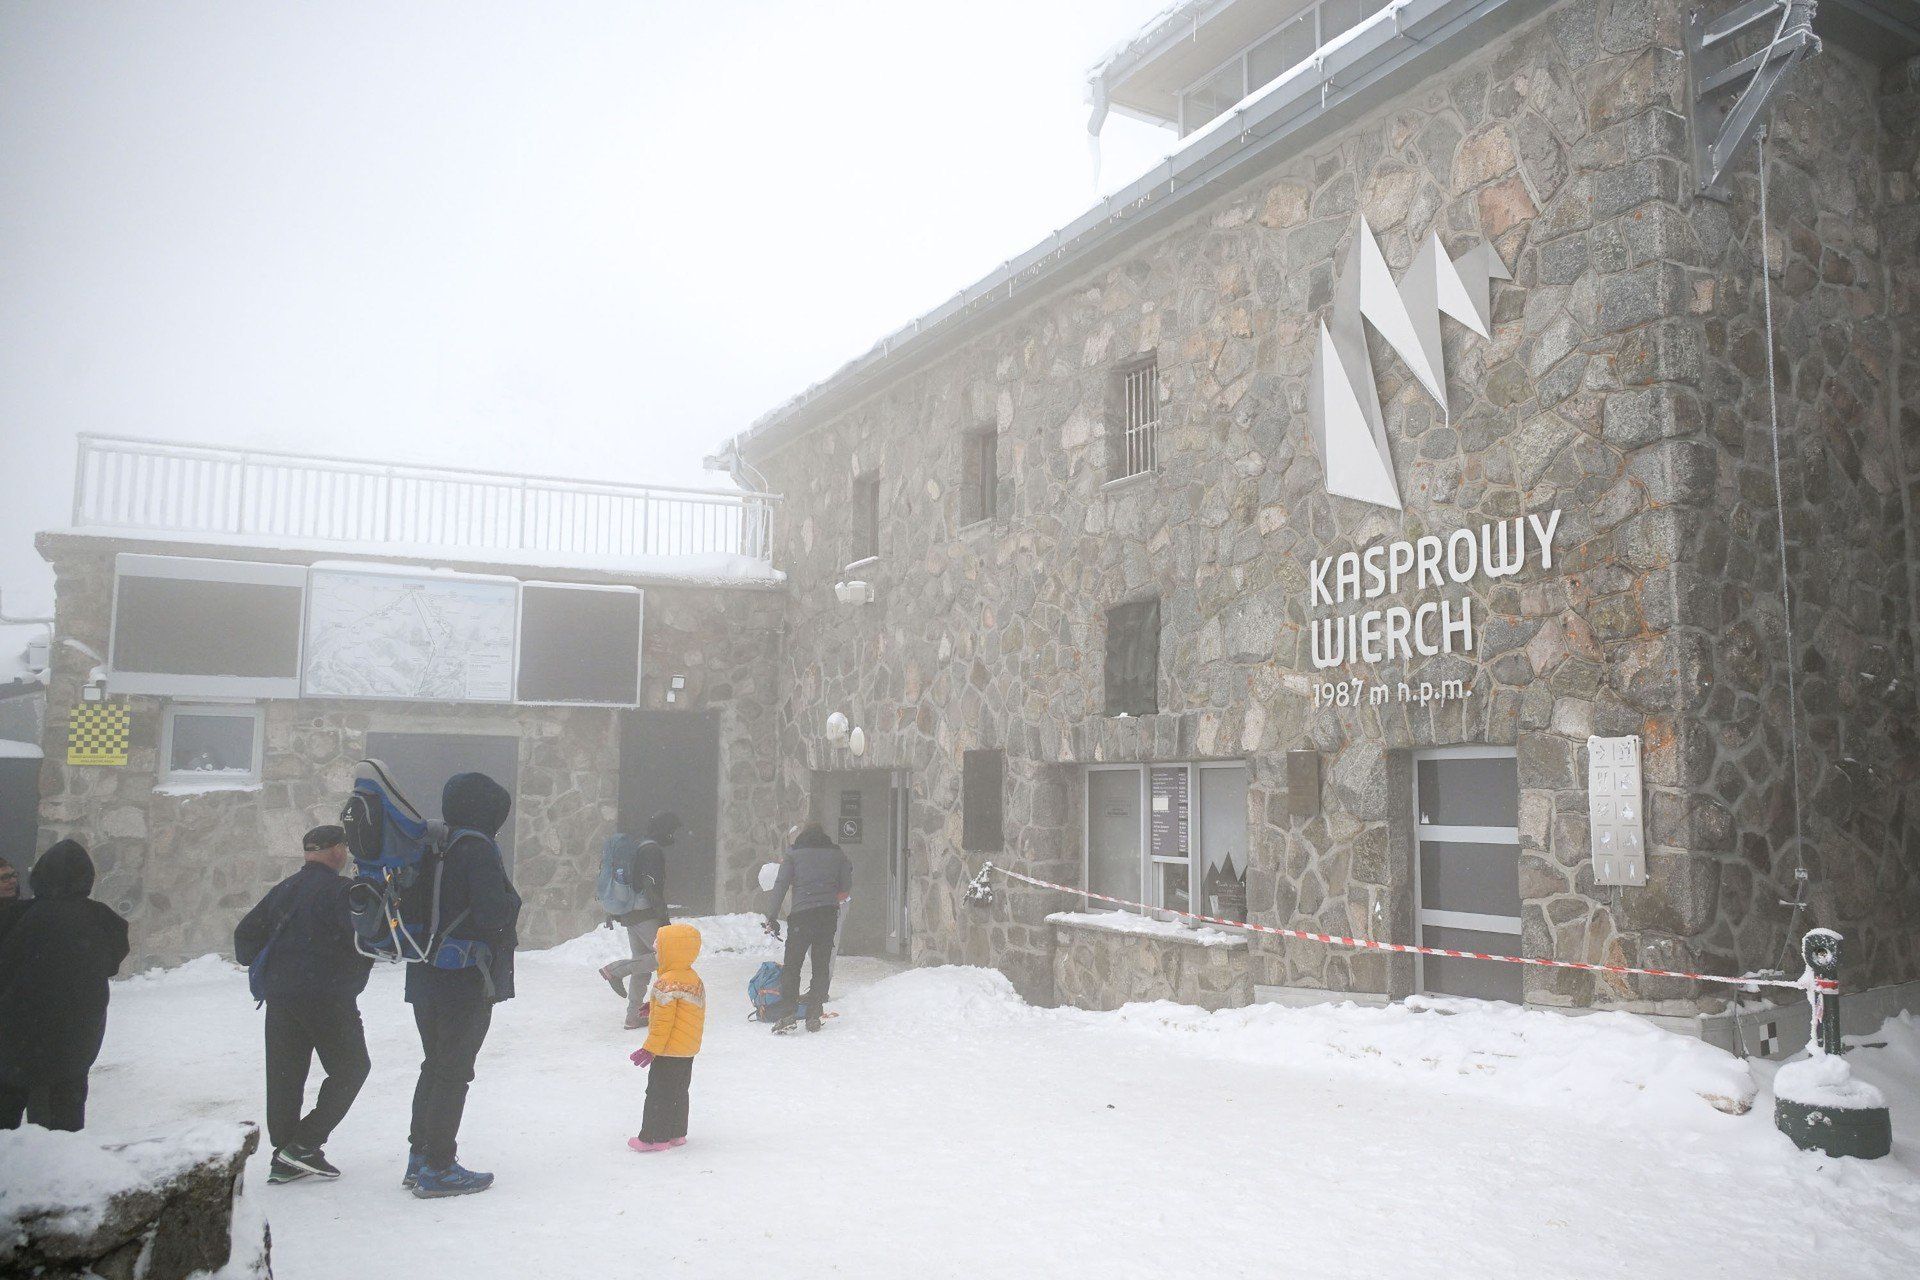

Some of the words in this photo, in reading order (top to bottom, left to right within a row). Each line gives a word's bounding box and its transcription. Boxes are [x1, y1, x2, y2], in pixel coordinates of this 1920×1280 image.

[1310, 509, 1561, 606] KASPROWY
[1311, 596, 1472, 669] WIERCH
[1313, 677, 1363, 707] 1987
[1369, 684, 1389, 705] m
[1397, 678, 1472, 707] n.p.m.
